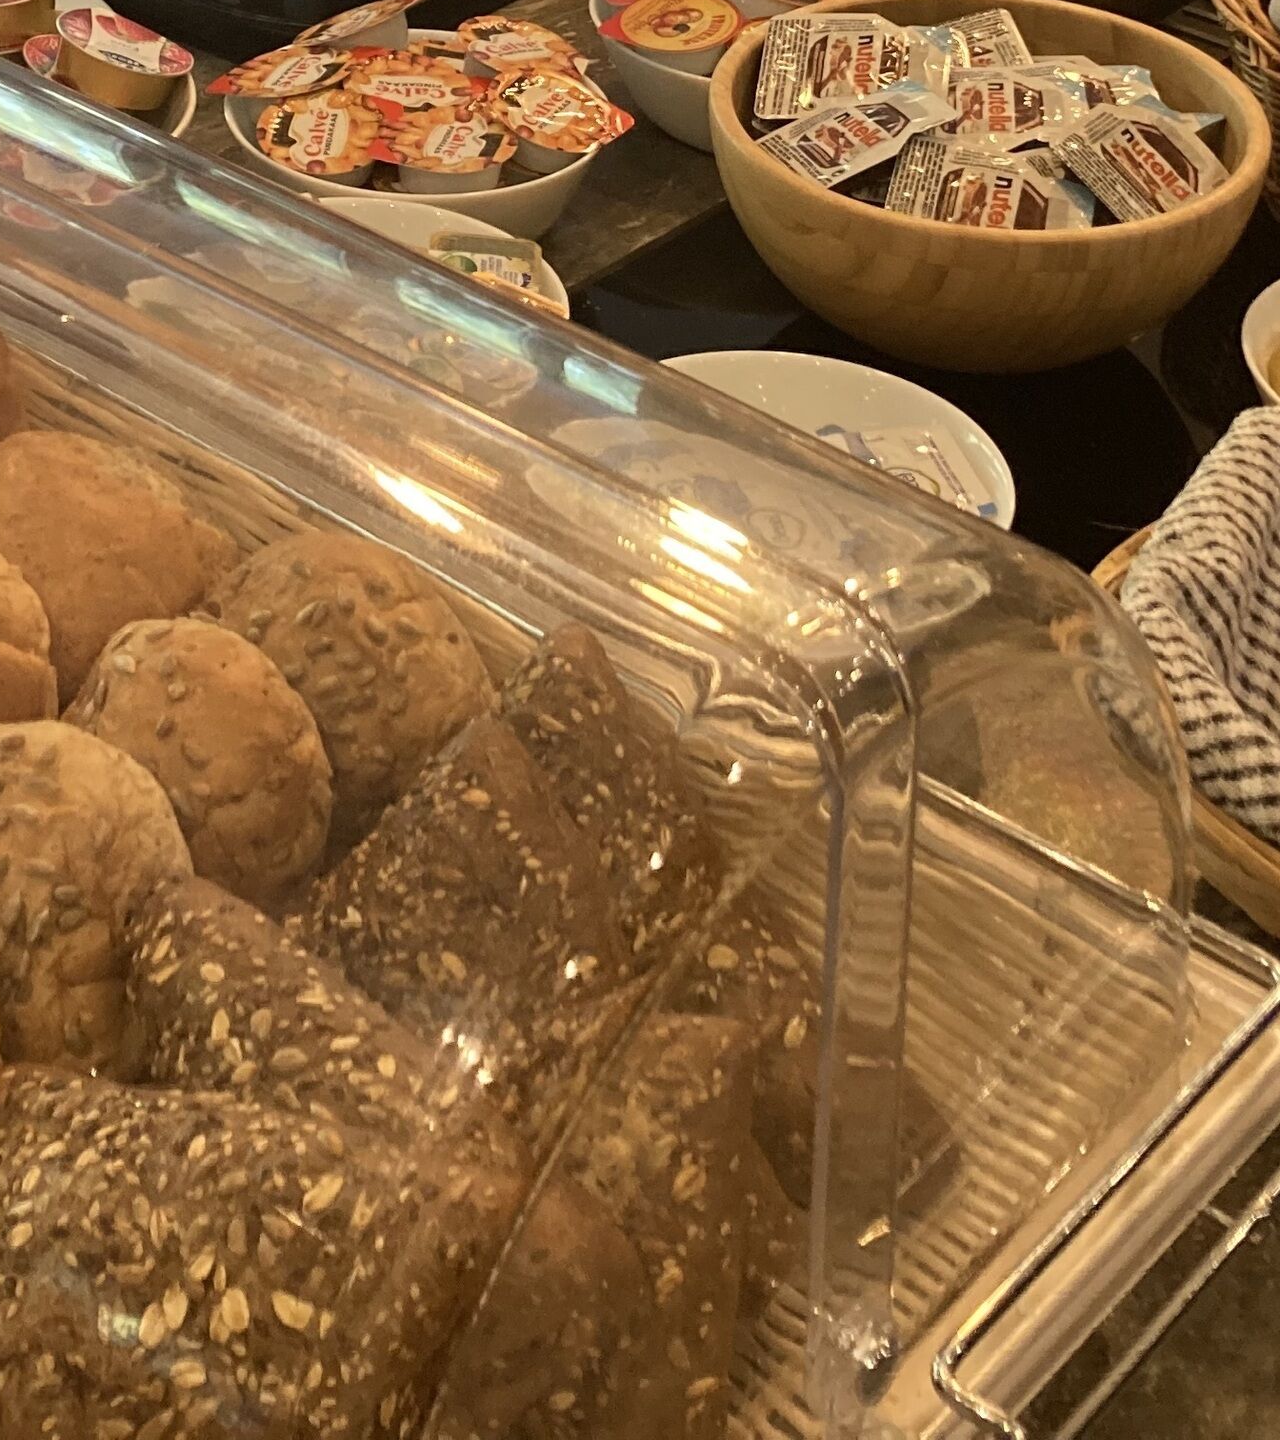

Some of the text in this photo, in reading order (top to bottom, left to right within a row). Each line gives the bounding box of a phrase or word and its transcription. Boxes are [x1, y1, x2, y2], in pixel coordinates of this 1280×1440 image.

[833, 111, 887, 149] nutella
[987, 82, 1013, 132] nutella
[303, 110, 331, 158] Calvé
[322, 112, 339, 157] PINDAKAAS
[441, 125, 474, 160] Calvé
[1120, 128, 1191, 202] nutella
